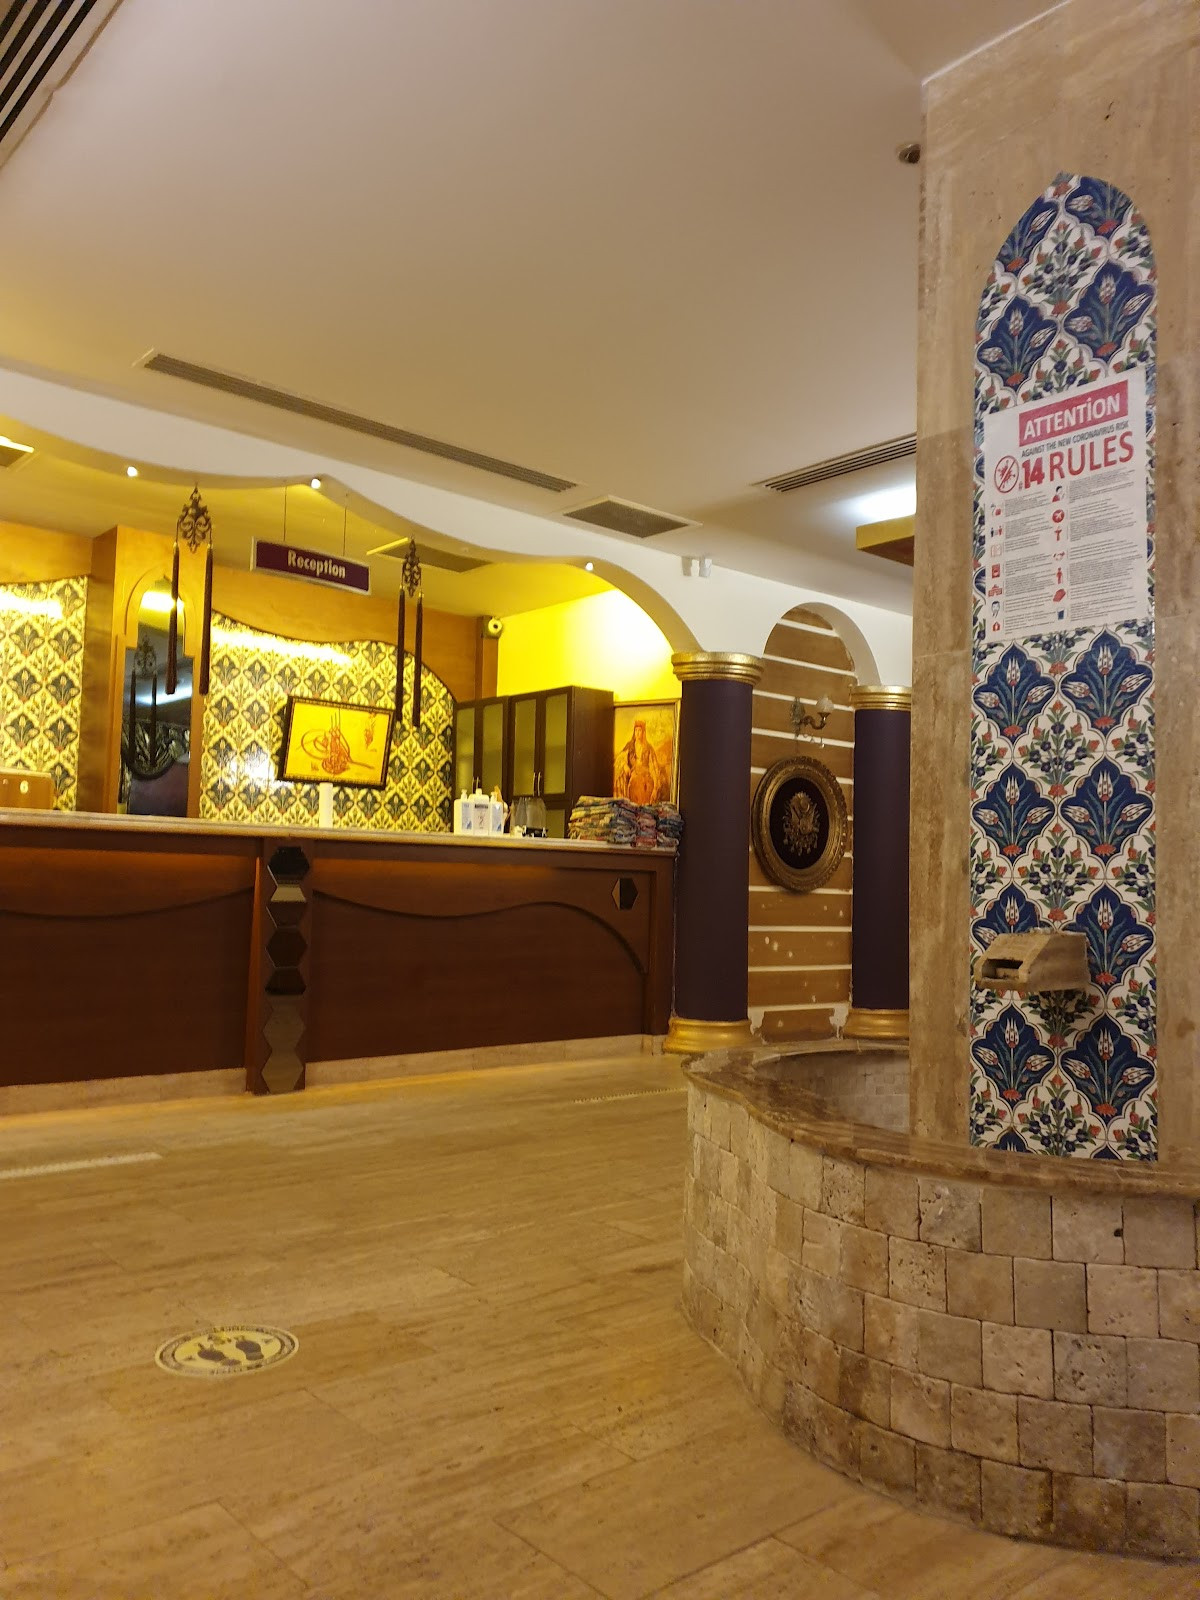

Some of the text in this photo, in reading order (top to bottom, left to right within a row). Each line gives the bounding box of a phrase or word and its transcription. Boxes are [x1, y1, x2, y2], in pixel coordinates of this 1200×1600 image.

[1021, 420, 1129, 458] AGAINST THE NEW CORONAVIRUS RISK
[1021, 431, 1134, 489] 14 RULES
[287, 549, 346, 578] Reception
